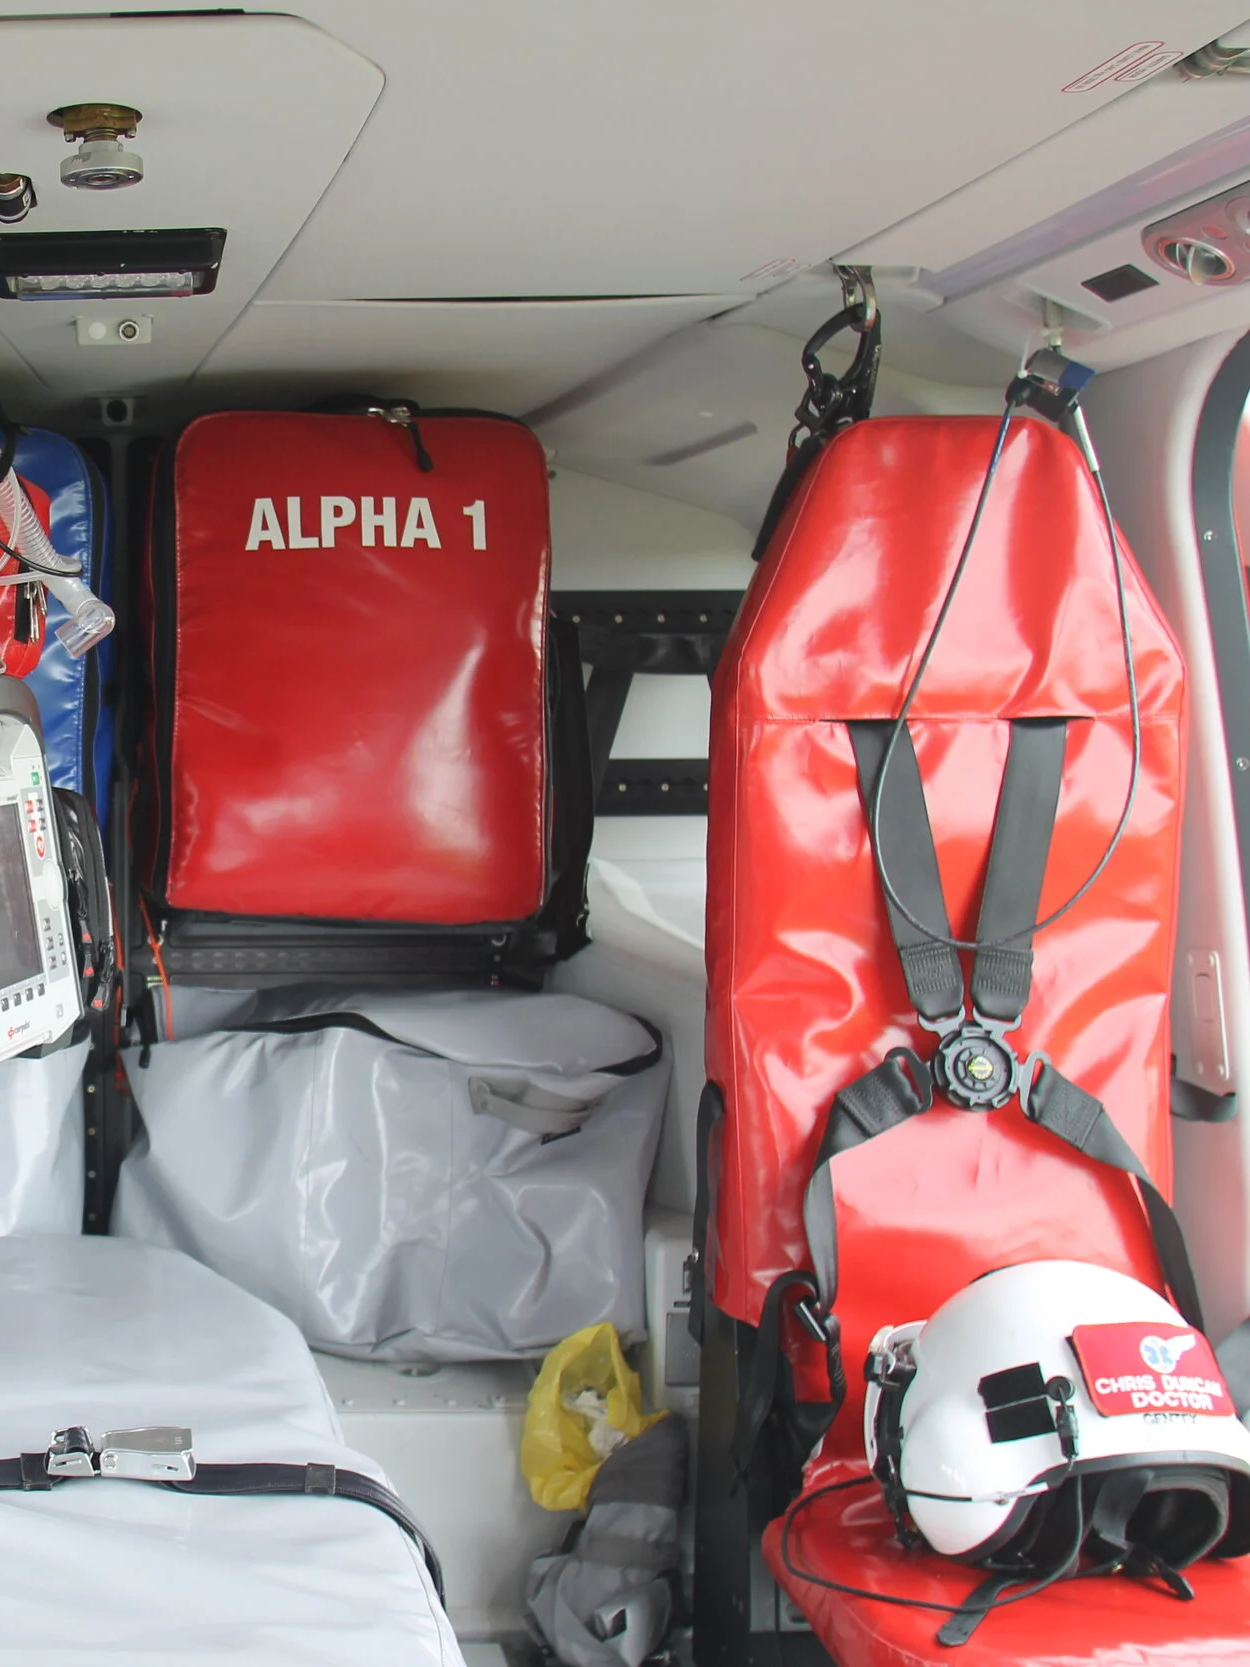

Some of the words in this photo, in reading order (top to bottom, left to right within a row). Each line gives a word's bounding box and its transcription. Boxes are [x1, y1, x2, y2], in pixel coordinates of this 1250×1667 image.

[245, 496, 442, 550] ALPHA
[463, 500, 486, 550] 1
[1095, 1375, 1156, 1394] CHRIS
[1160, 1374, 1223, 1396] DUNCAN
[1130, 1391, 1214, 1410] DOCTOR
